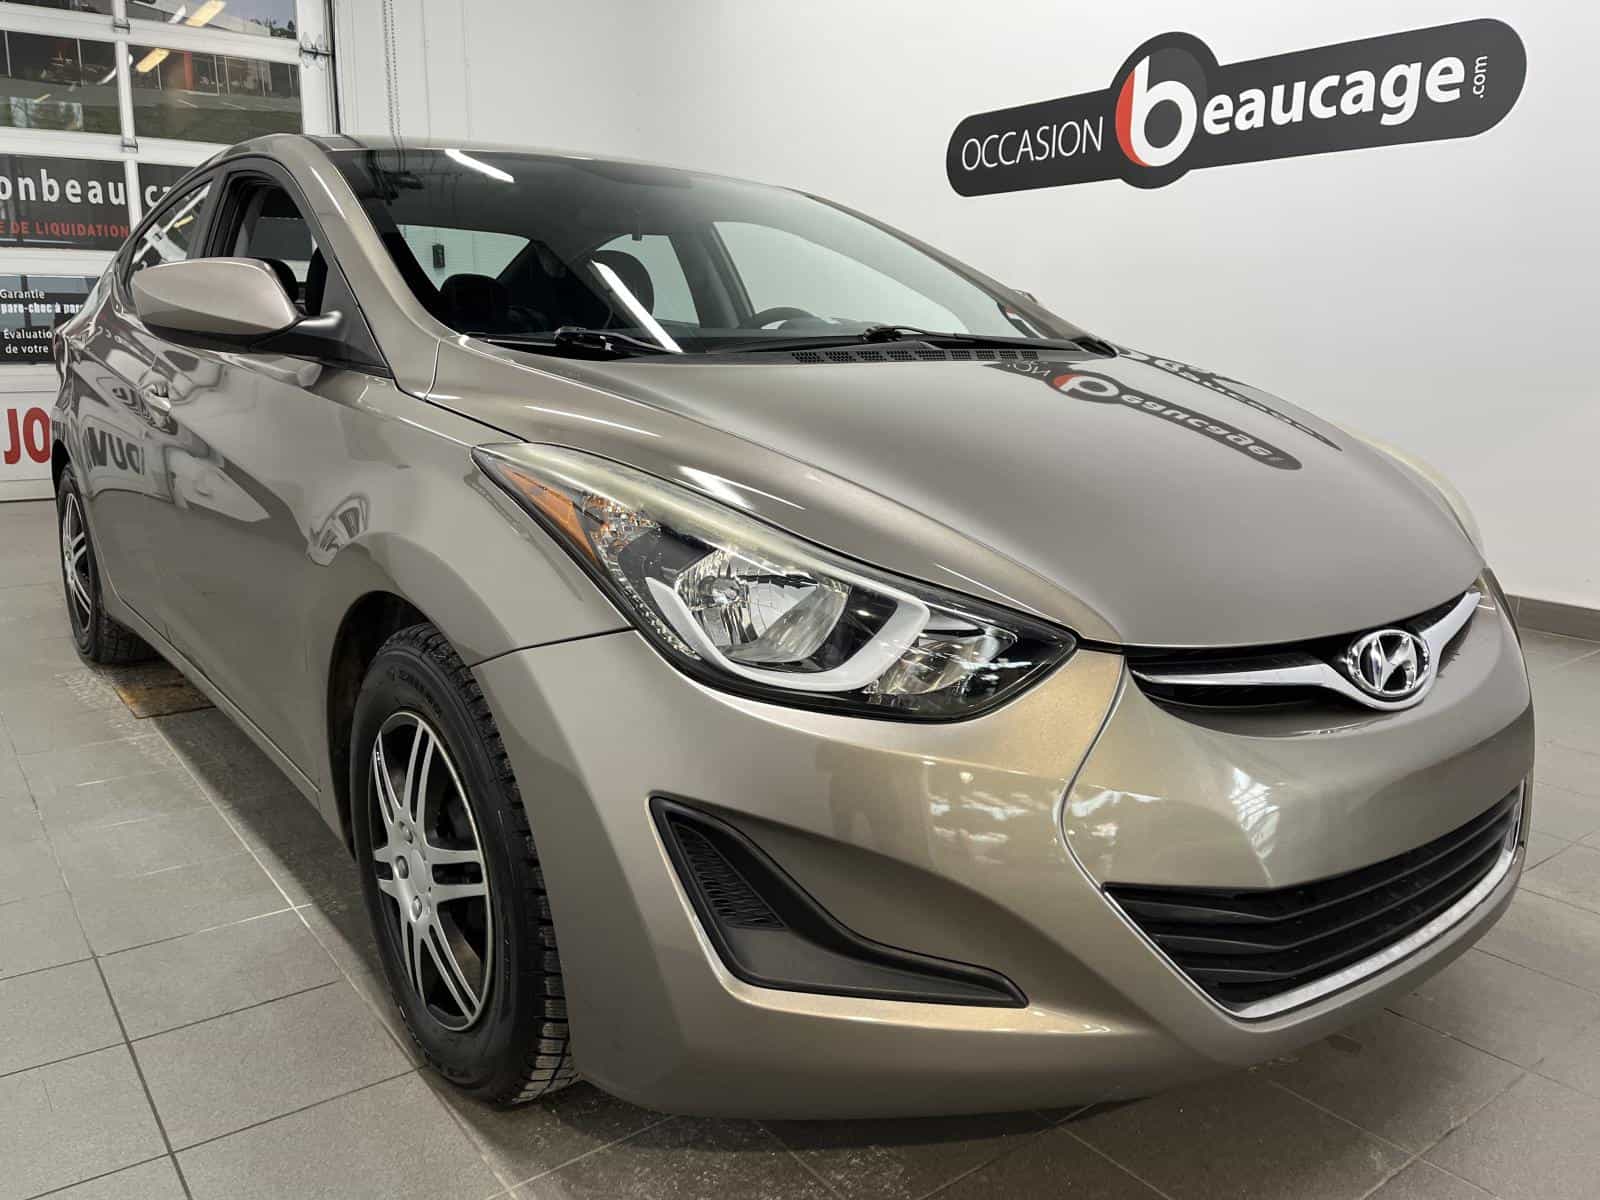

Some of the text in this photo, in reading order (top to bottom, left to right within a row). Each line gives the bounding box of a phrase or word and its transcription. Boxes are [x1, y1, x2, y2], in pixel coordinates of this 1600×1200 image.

[961, 55, 1488, 171] OCCASION beaucage .com
[10, 221, 30, 235] DE
[35, 221, 129, 238] LIQUIDATION
[0, 288, 46, 300] Garantie
[3, 328, 56, 340] Évaluatio
[5, 343, 49, 354] de votre
